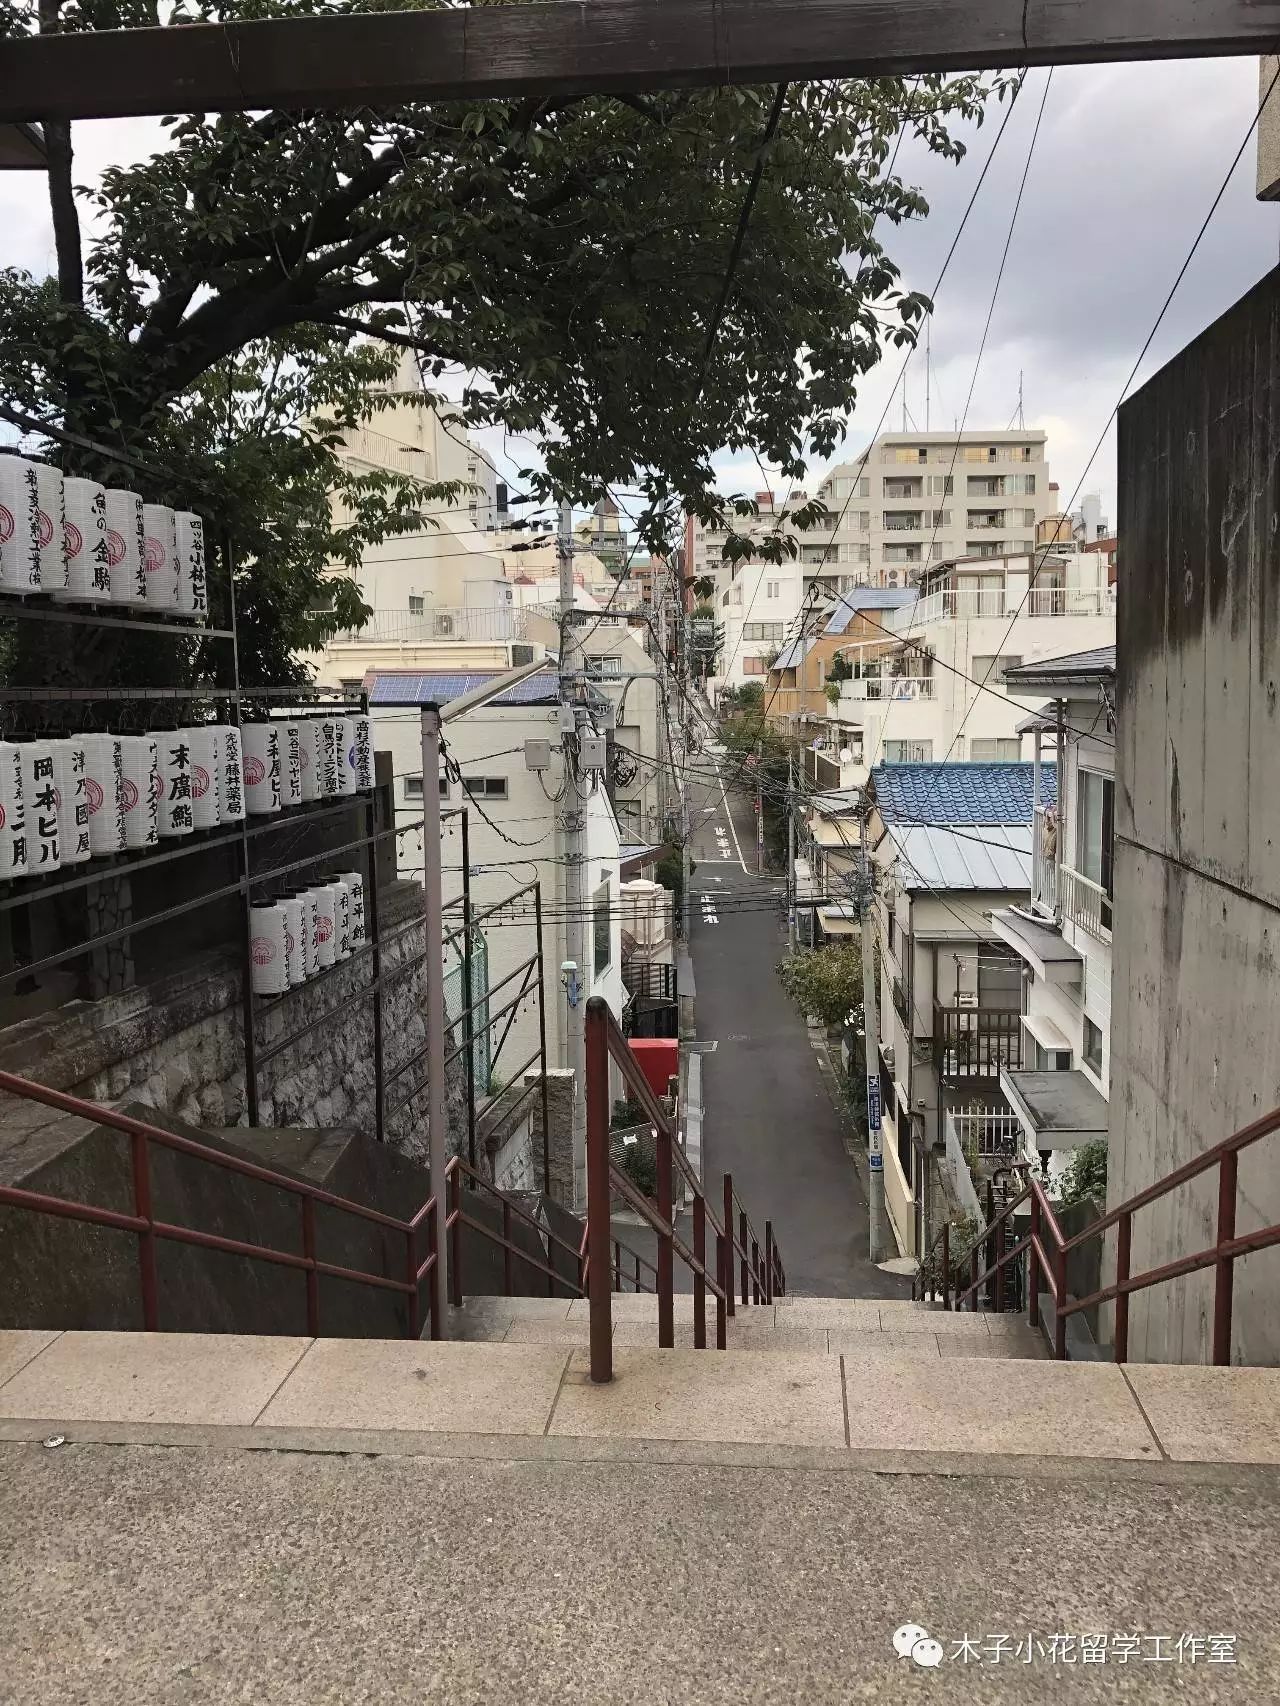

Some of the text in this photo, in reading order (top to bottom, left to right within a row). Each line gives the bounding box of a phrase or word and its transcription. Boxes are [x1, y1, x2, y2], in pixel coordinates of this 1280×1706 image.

[32, 756, 60, 864] 岡本ビル
[224, 732, 242, 815] 完成堂藤井薬局
